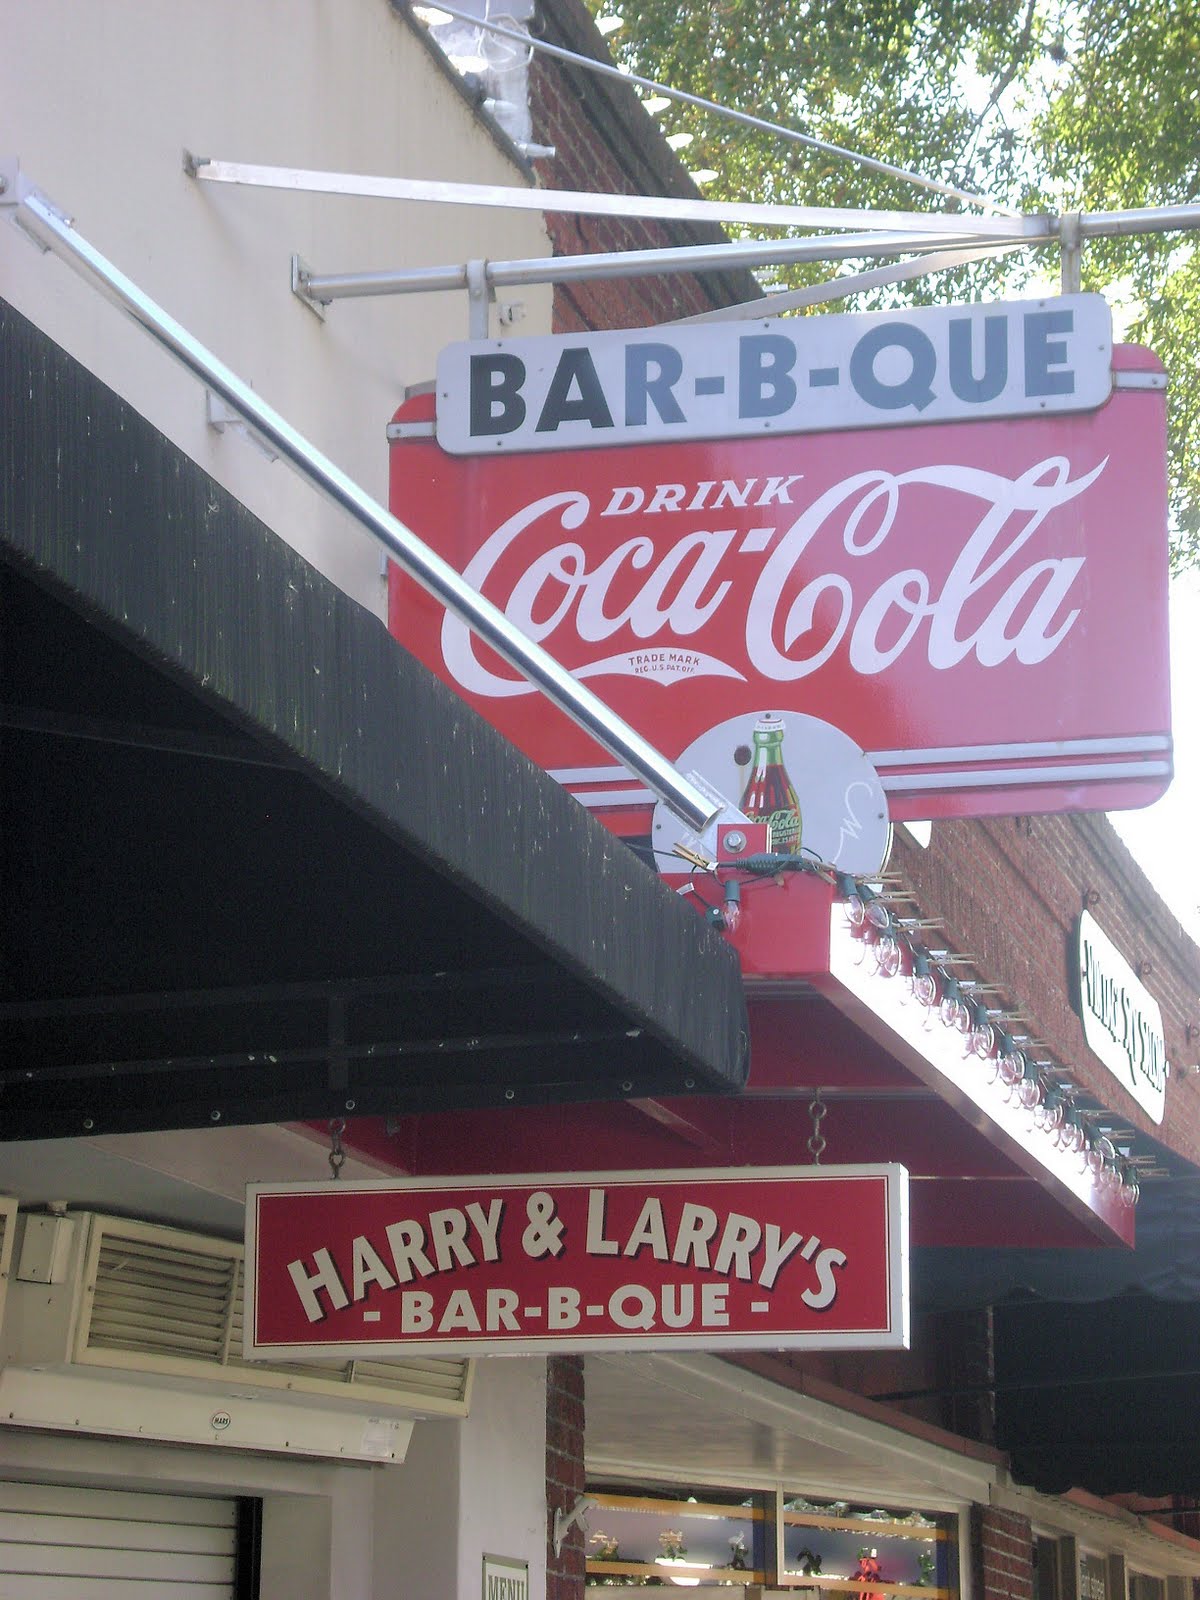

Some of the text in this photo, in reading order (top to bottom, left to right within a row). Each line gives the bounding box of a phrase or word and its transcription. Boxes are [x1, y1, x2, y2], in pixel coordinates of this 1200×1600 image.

[468, 309, 1076, 438] BAR-B-QUE
[600, 474, 804, 516] DRINK
[441, 454, 1110, 697] Coca-Cola
[628, 653, 700, 666] TRADE MARK
[287, 1188, 849, 1324] HARRY & LARRY'S
[401, 1283, 731, 1334] BAR-B-QUE
[487, 1573, 525, 1600] MENU
